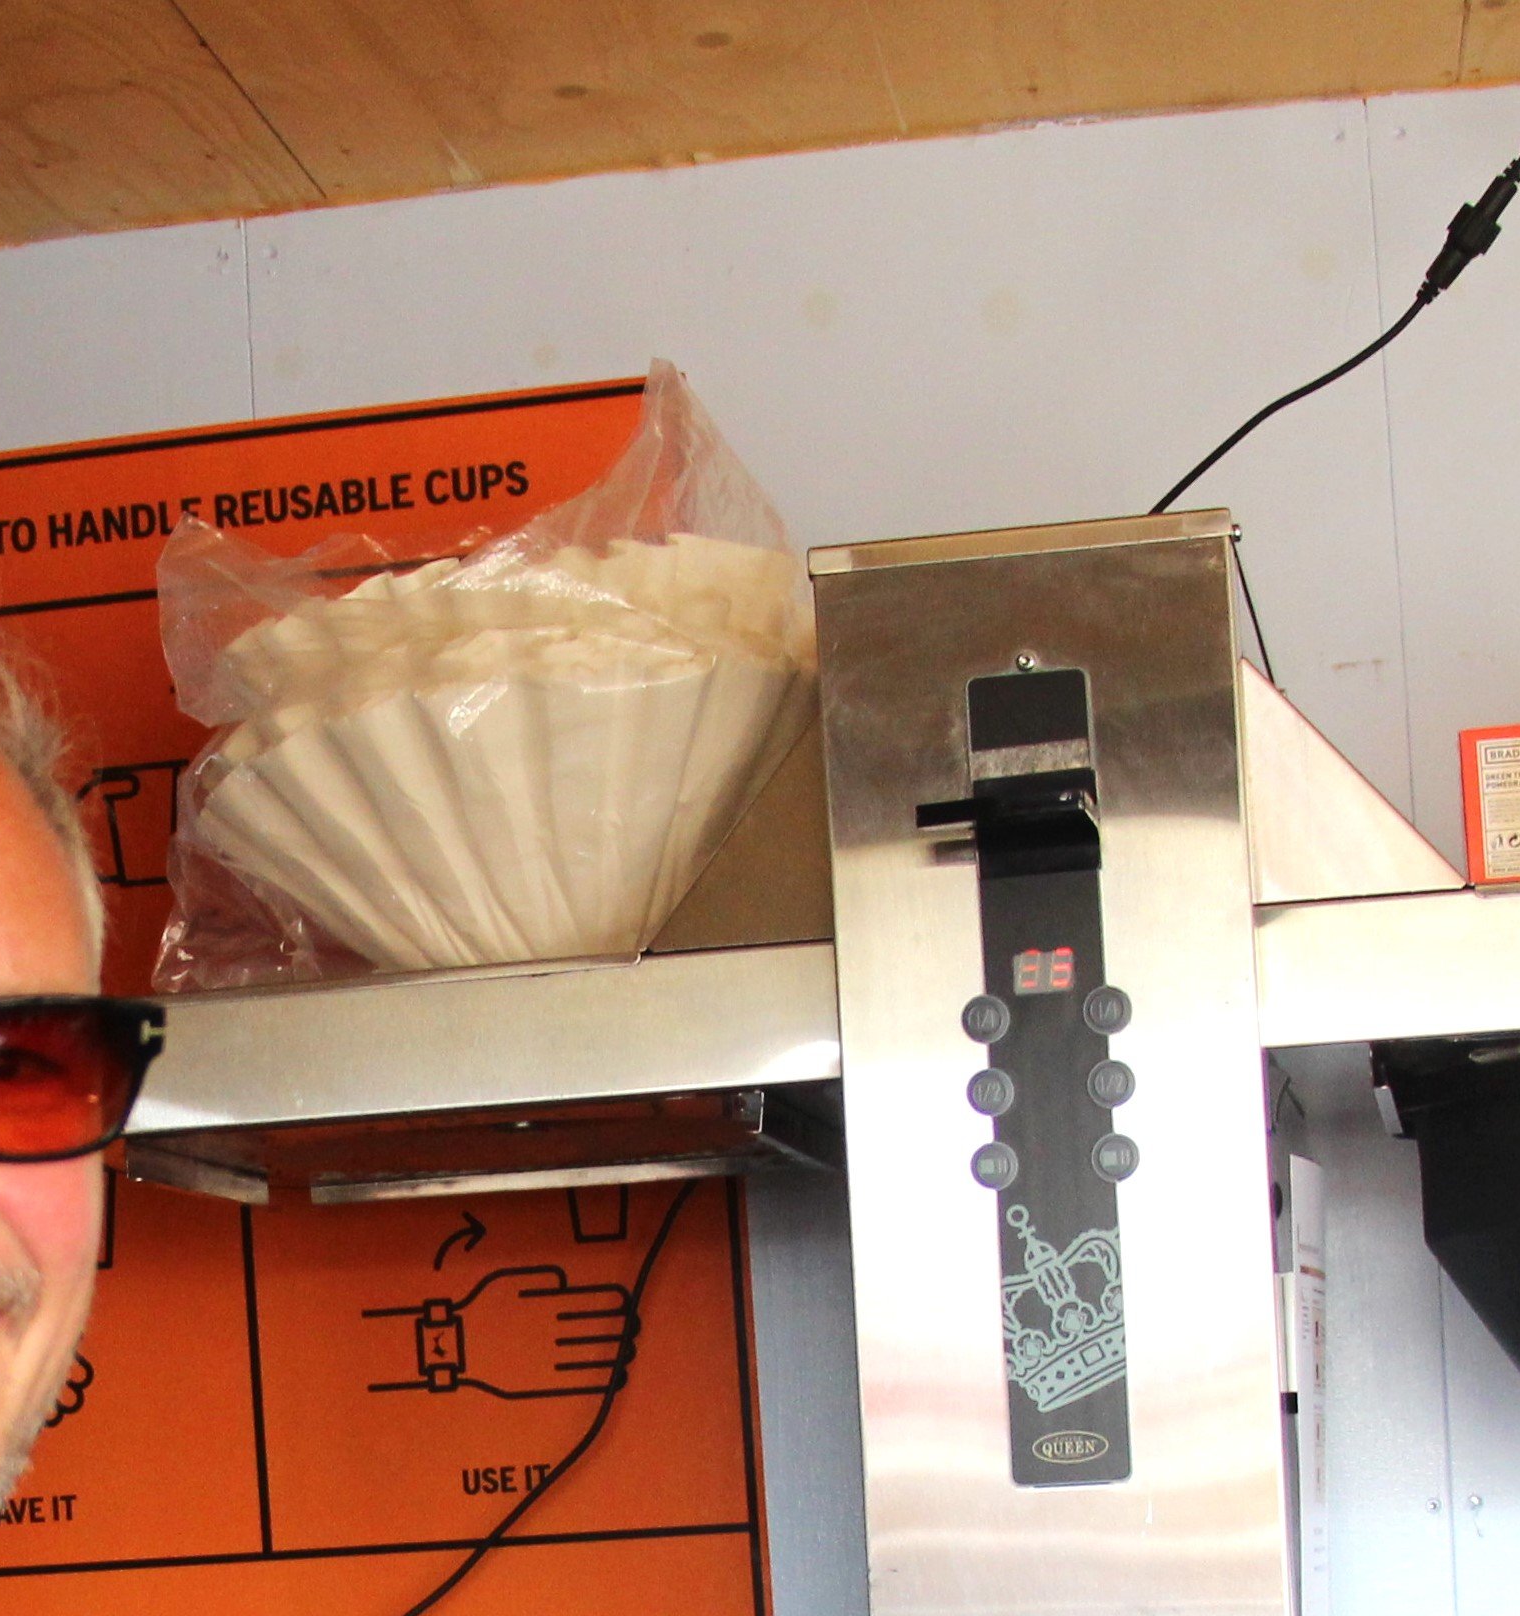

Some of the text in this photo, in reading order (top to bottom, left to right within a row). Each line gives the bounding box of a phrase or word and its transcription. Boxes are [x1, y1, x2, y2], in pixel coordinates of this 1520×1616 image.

[49, 496, 202, 548] HANDLE
[215, 473, 415, 530] REUSABLE
[424, 460, 531, 506] CUPS
[1042, 1440, 1095, 1458] QUEEN
[462, 1463, 551, 1495] USE IT
[52, 1494, 77, 1521] IT
